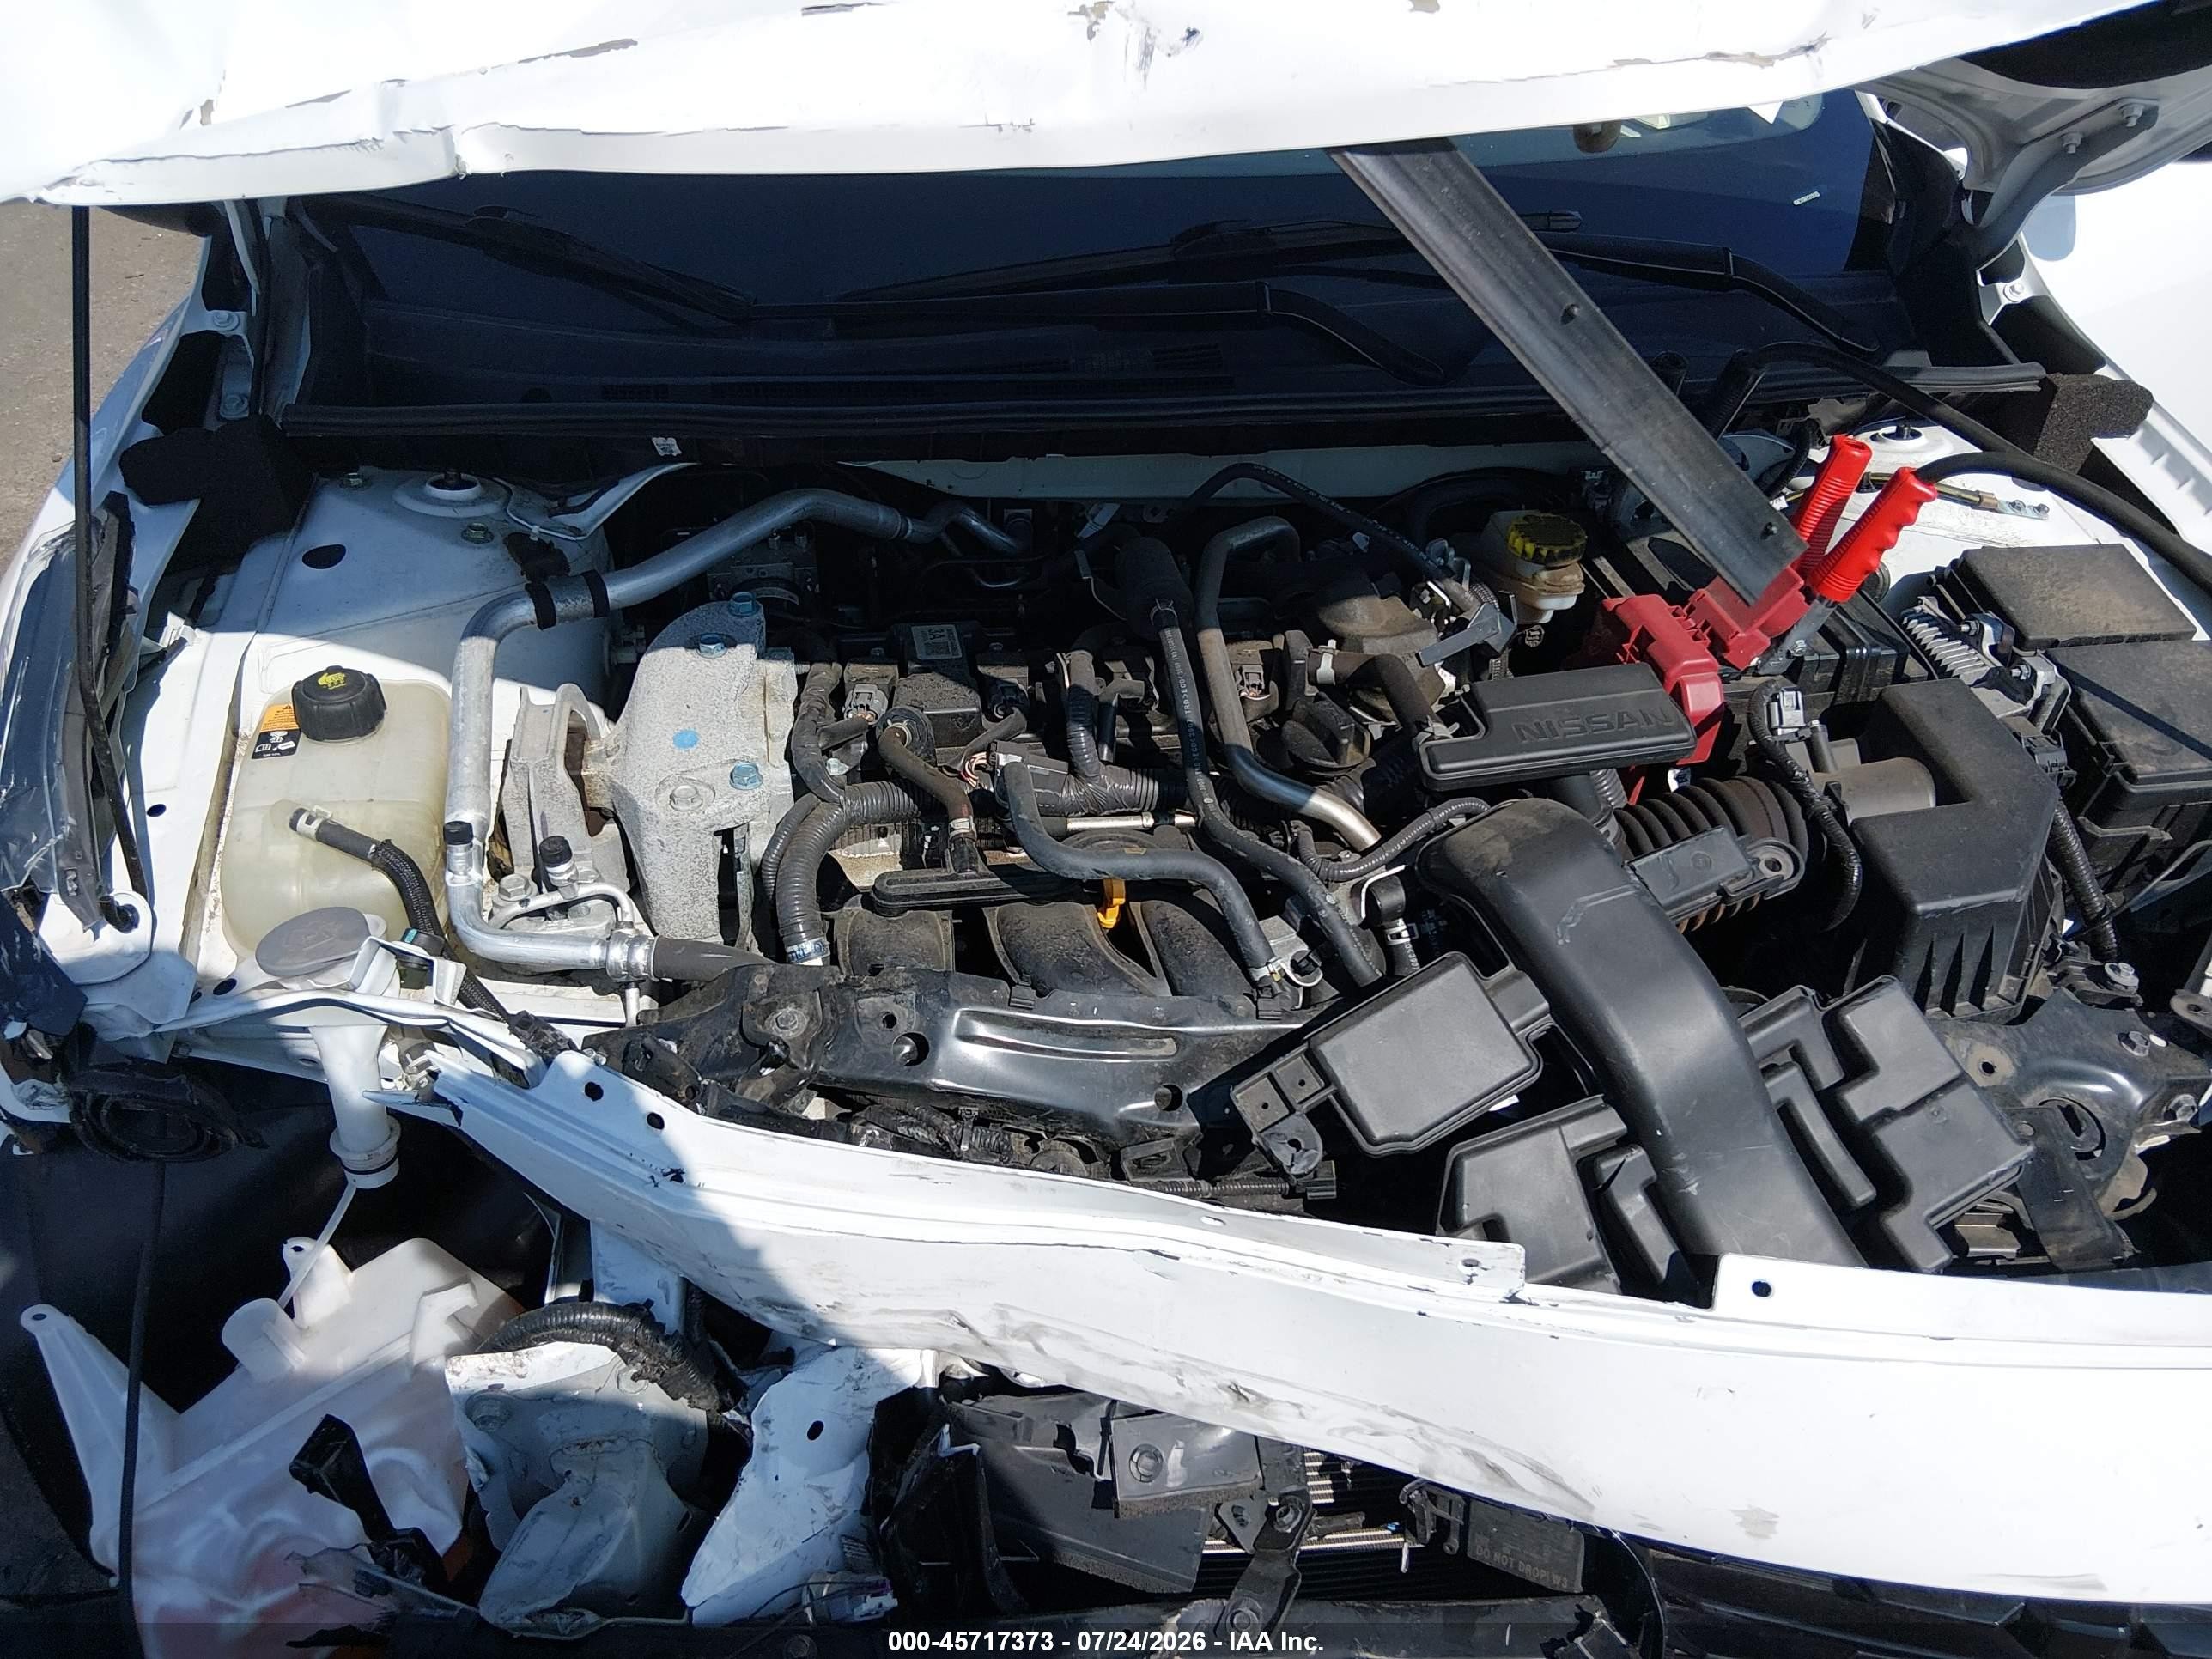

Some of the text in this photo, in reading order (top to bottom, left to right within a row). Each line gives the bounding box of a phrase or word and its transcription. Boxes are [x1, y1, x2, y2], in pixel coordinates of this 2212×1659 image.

[1513, 707, 1674, 742] NISSAN
[1476, 1545, 1491, 1559] DO
[1493, 1551, 1514, 1568] NOT
